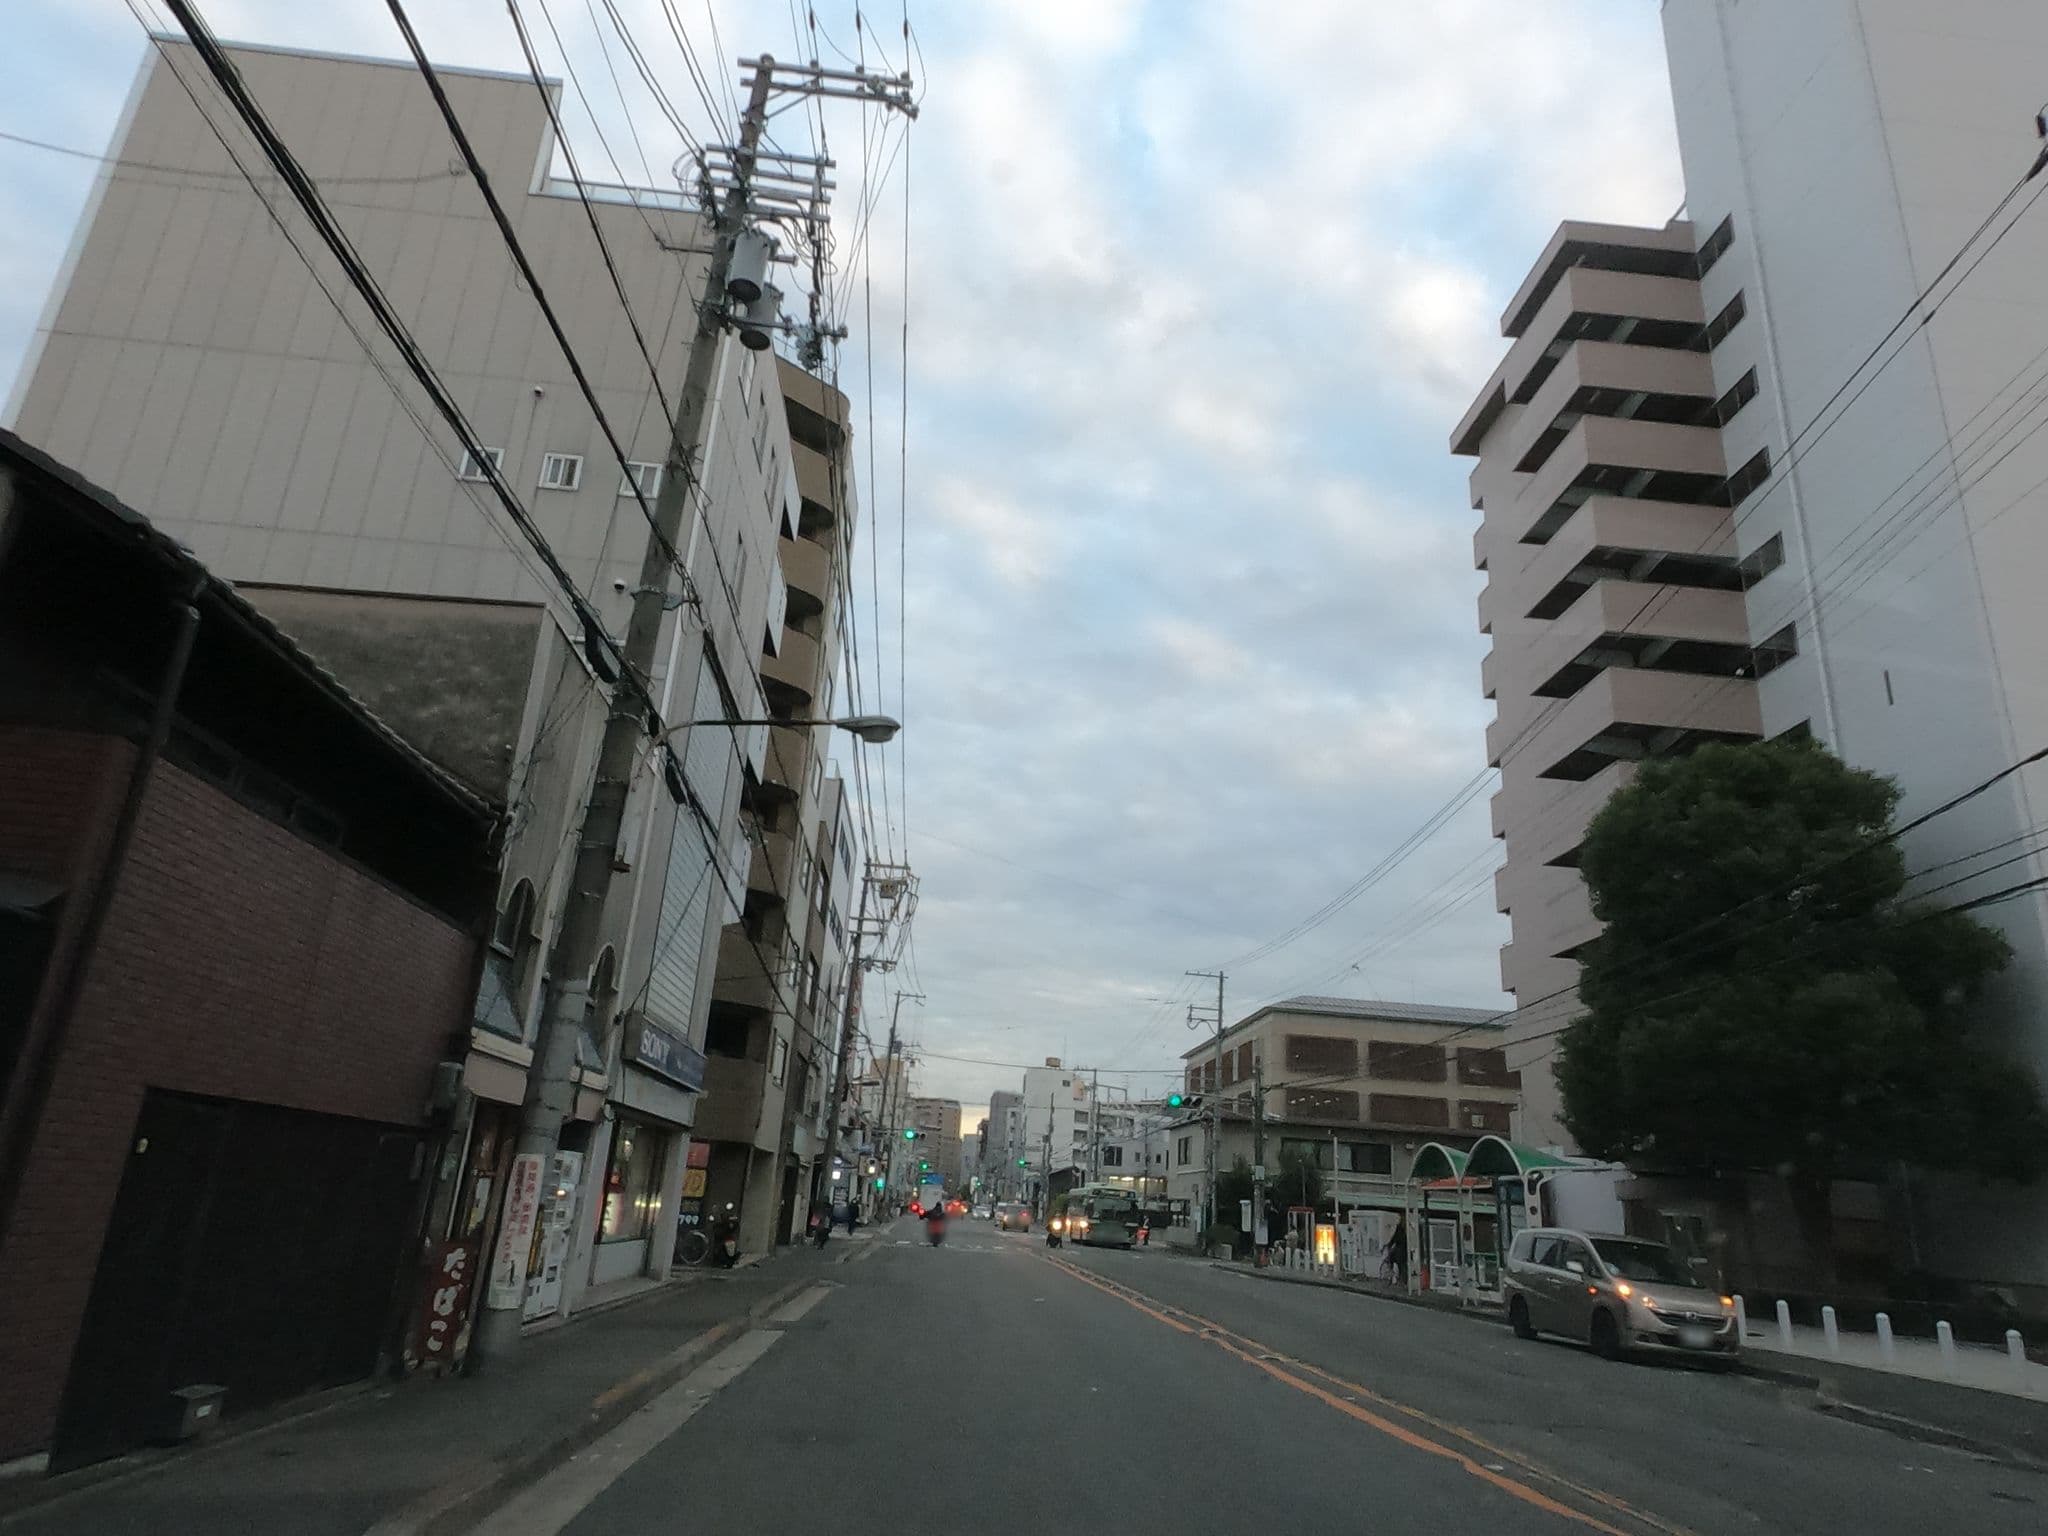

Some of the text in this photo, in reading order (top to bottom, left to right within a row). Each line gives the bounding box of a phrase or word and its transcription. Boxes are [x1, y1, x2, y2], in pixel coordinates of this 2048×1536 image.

[640, 1029, 671, 1065] SONY
[427, 1247, 467, 1352] たばこ
